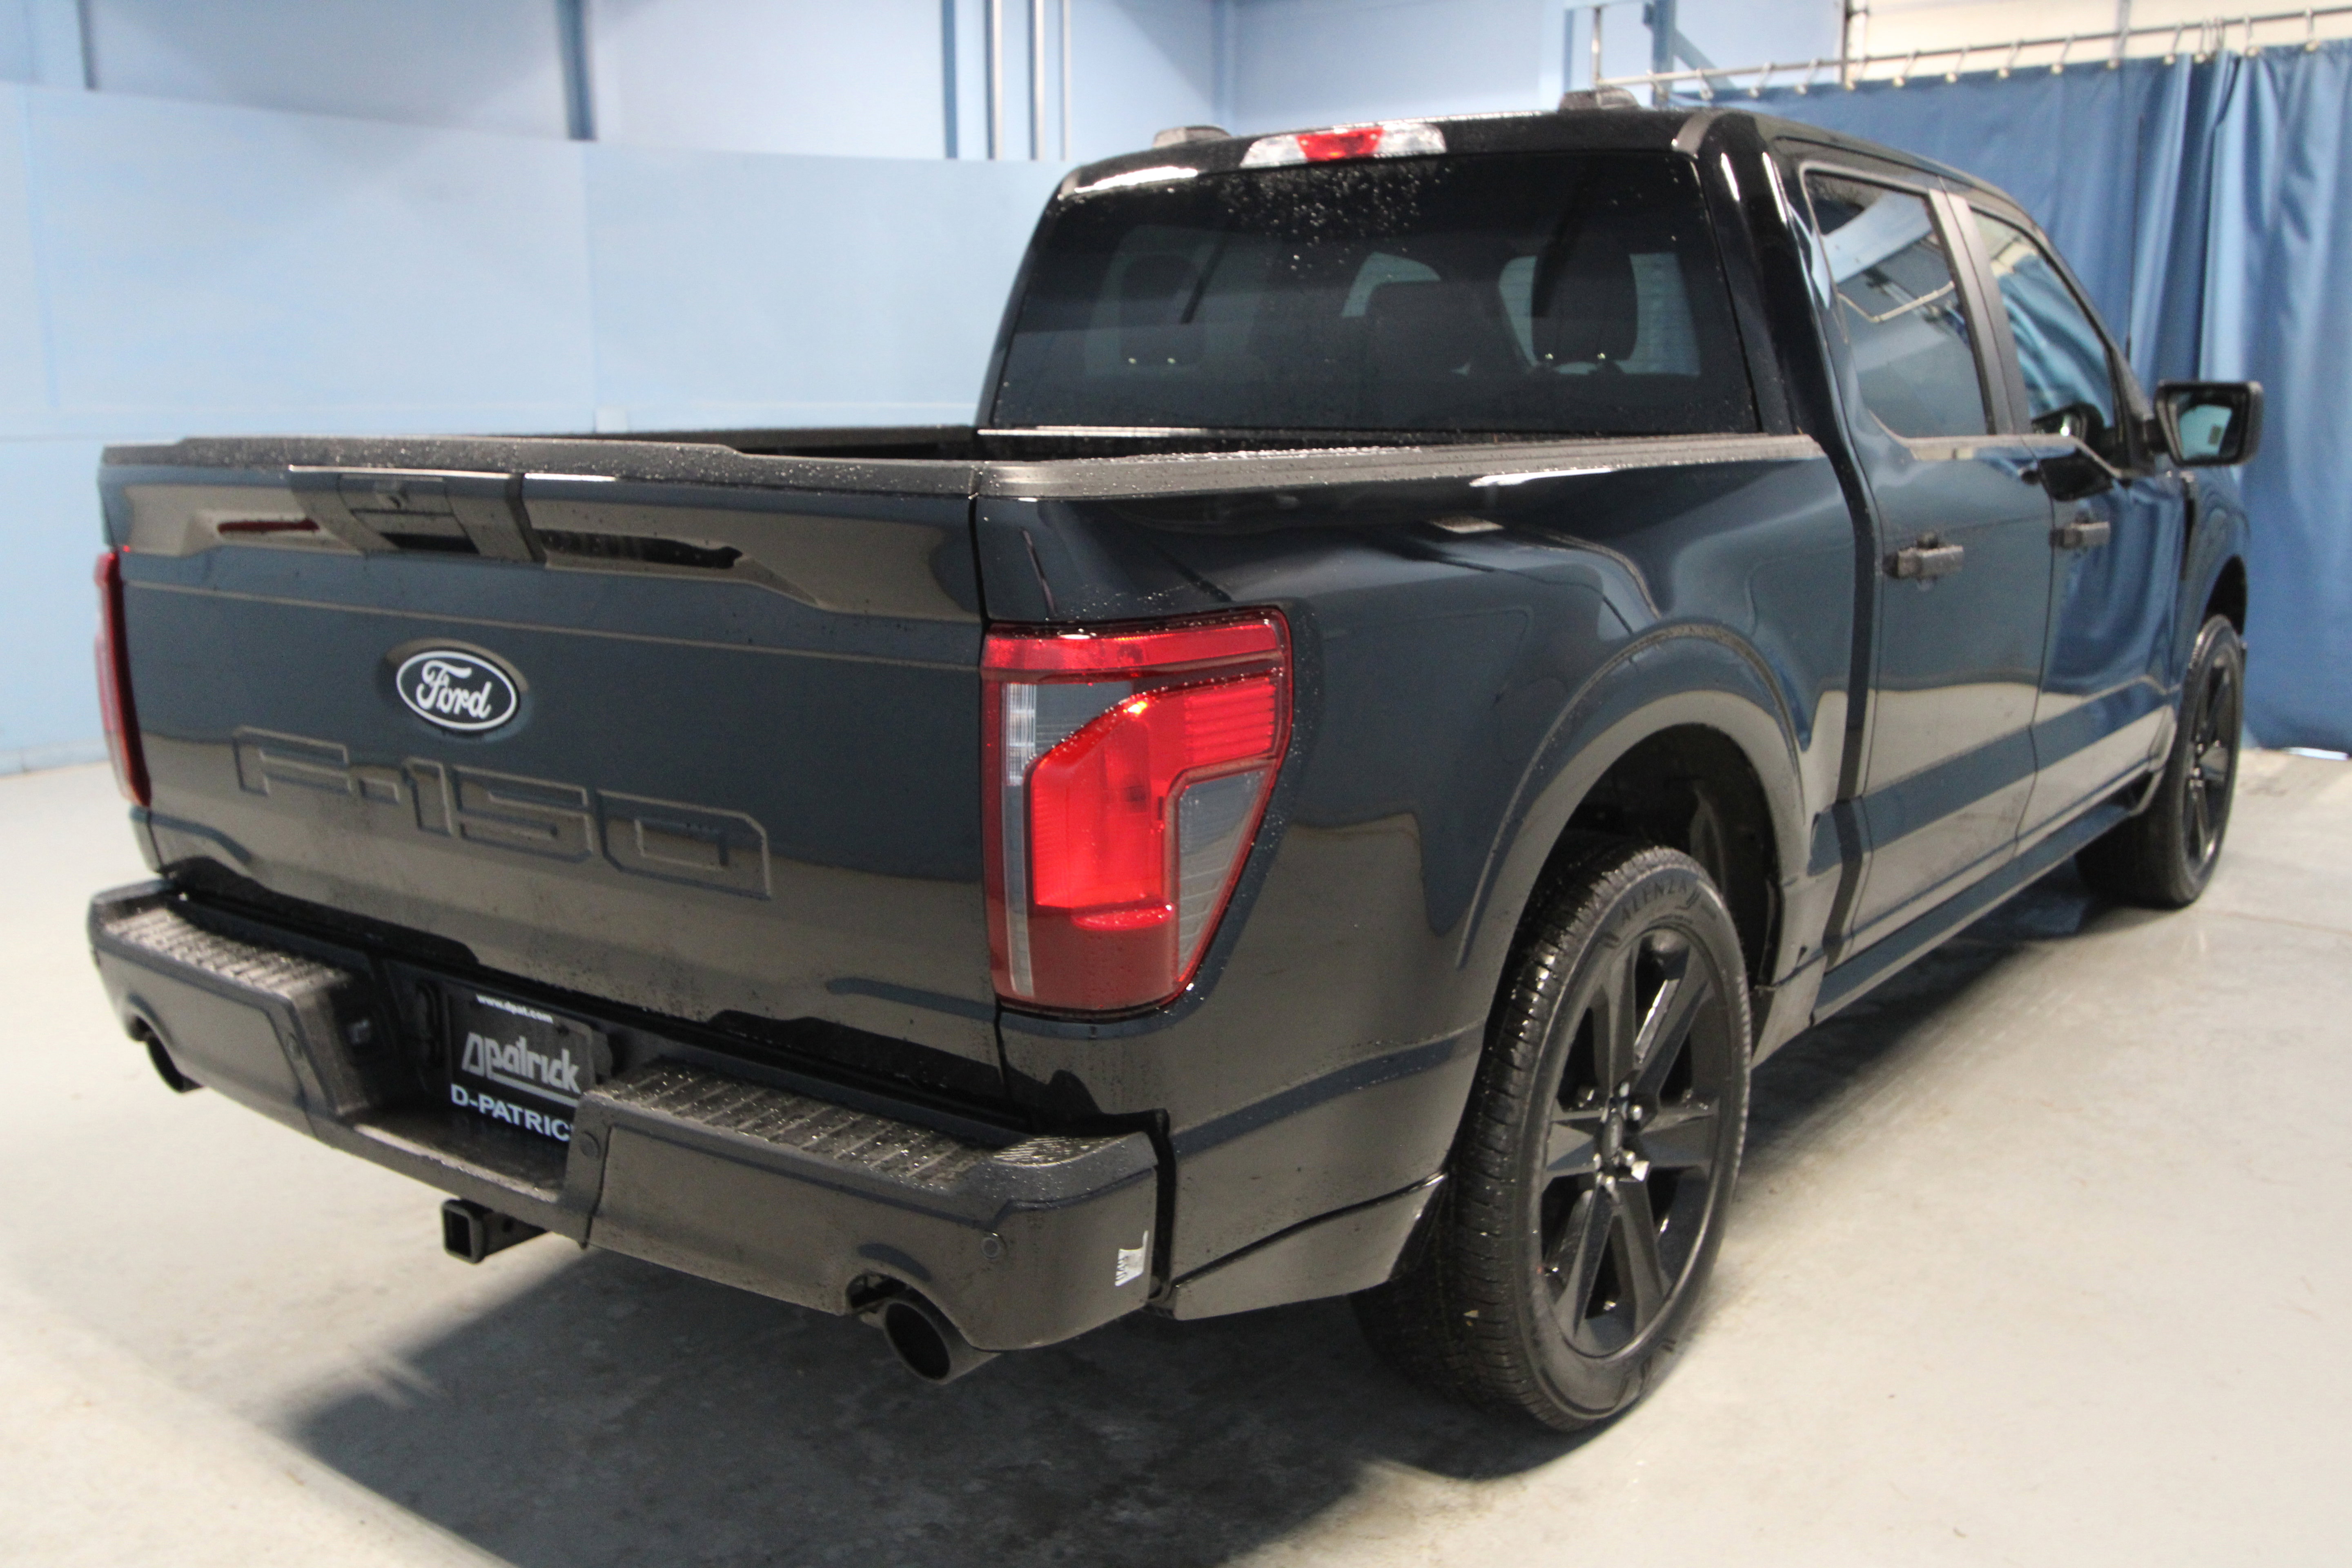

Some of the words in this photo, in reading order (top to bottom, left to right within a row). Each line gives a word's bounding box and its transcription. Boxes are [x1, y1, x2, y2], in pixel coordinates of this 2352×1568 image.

[416, 659, 492, 719] Ford
[232, 725, 772, 901] F-150
[450, 1082, 575, 1143] D-PATRIC
